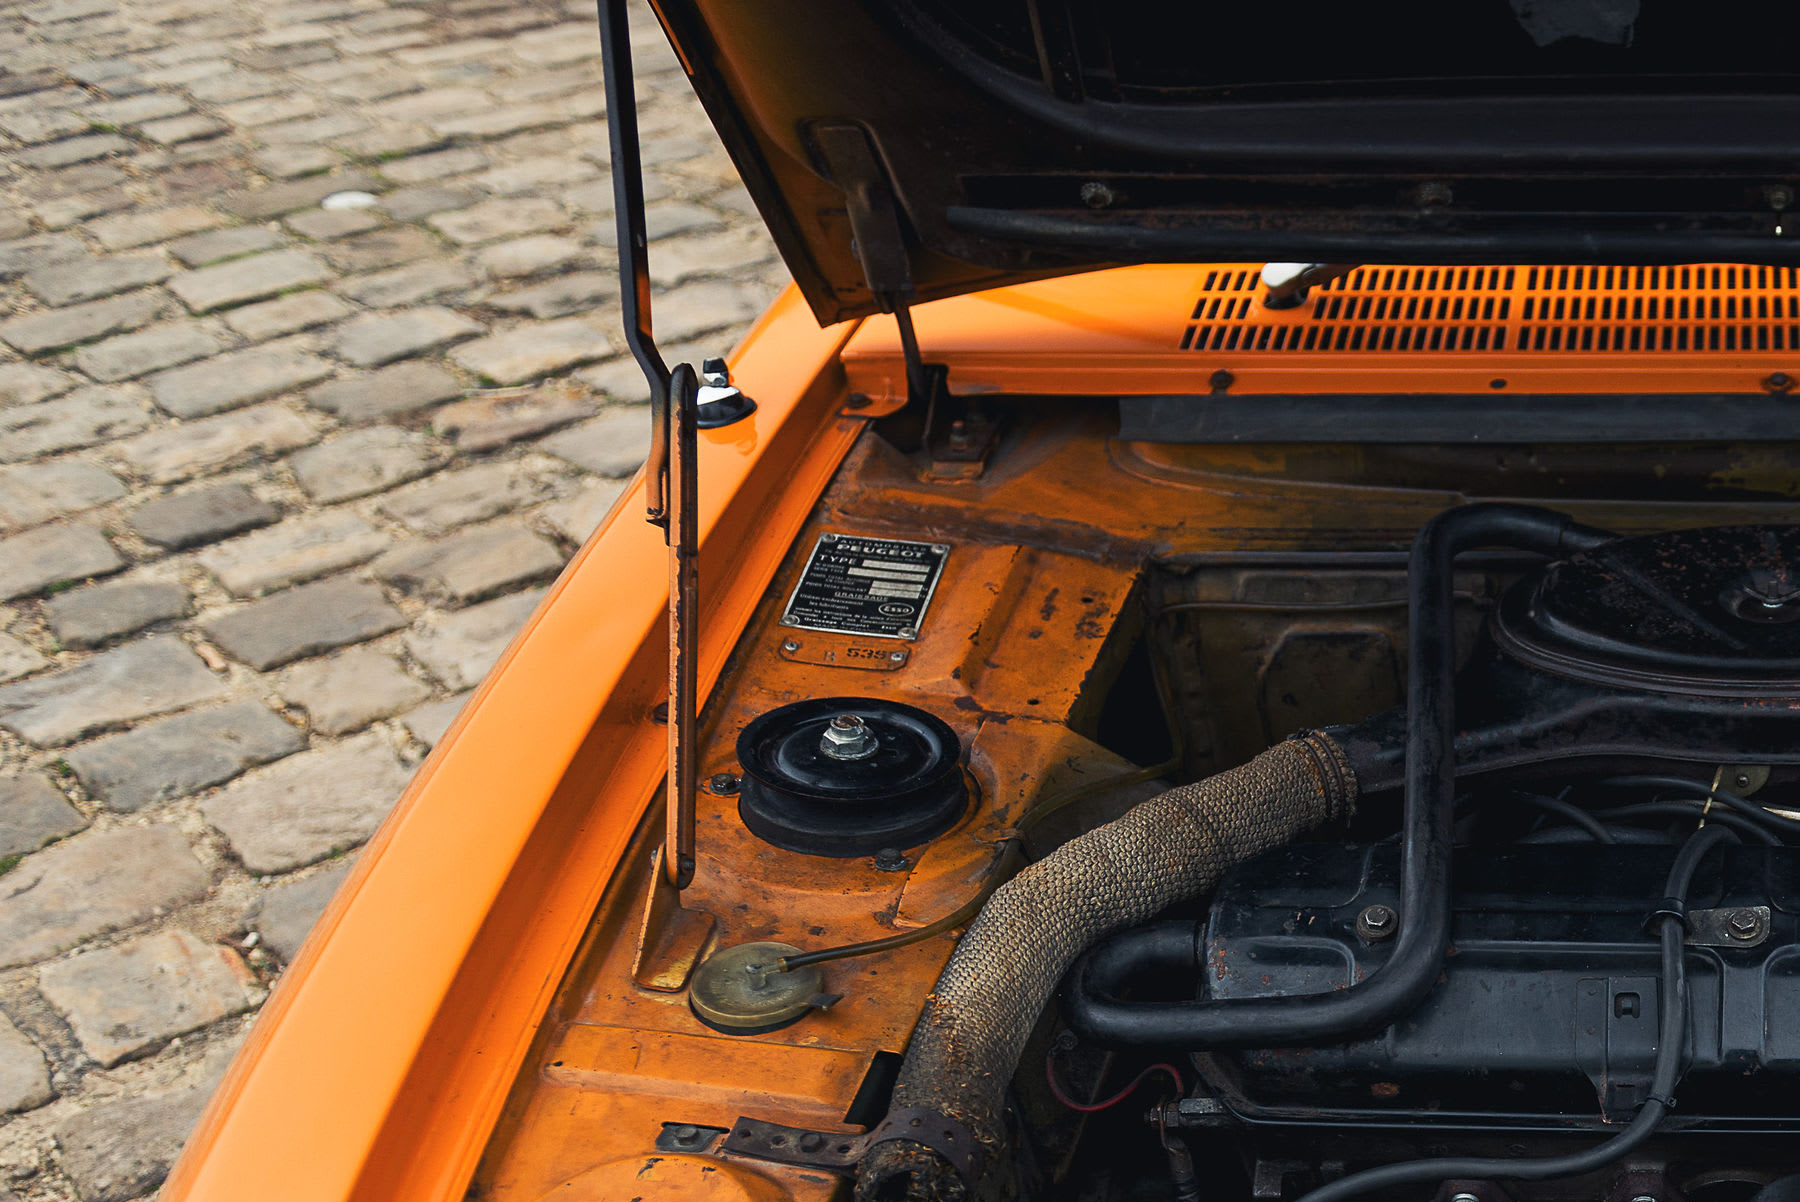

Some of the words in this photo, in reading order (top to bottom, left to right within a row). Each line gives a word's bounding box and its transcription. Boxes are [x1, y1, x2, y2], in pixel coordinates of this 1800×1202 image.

[836, 544, 926, 558] PEUGEOT
[840, 539, 926, 551] AUTOMOBILES
[819, 554, 858, 565] TYPE
